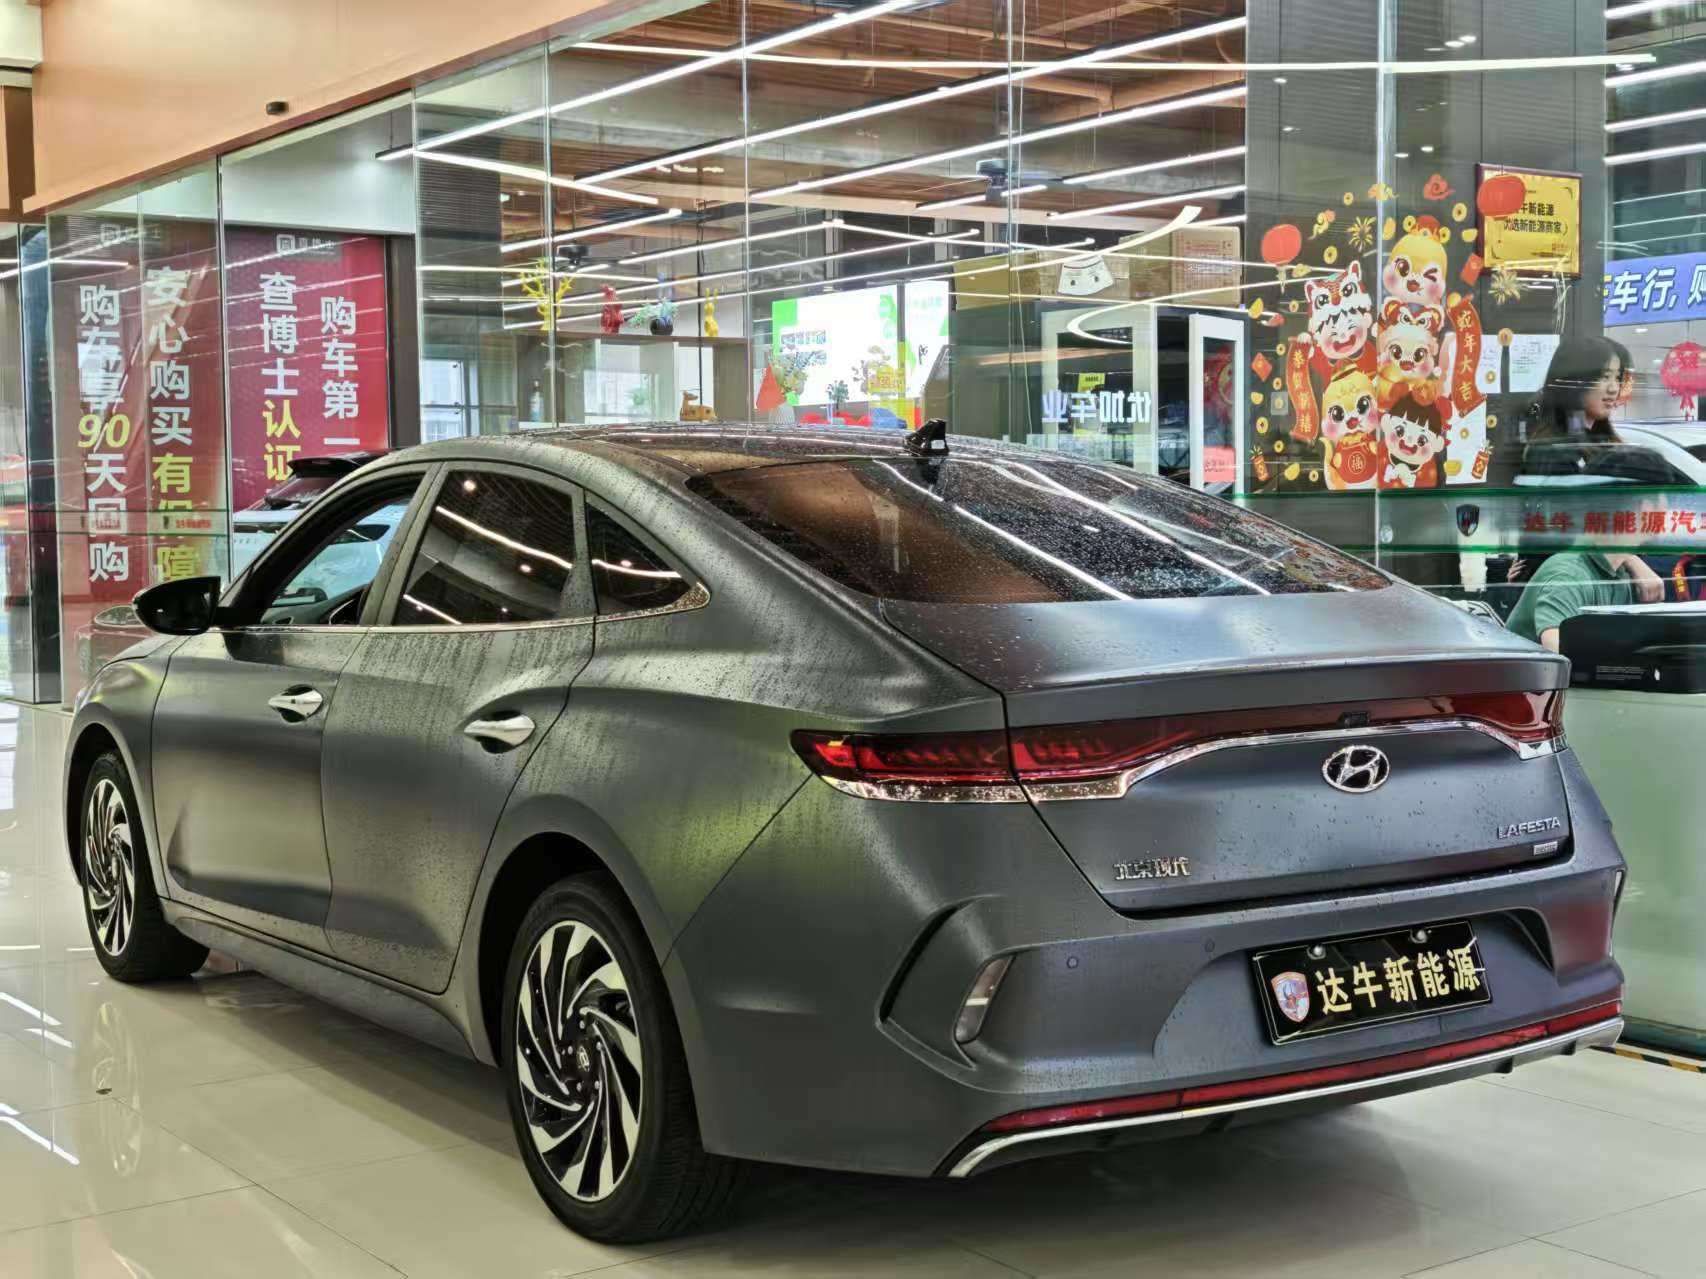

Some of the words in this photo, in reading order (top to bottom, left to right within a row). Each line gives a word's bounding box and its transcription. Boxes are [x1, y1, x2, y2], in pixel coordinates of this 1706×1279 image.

[320, 296, 361, 446] 购车第一
[1498, 816, 1561, 839] LAFESTA
[1113, 857, 1192, 880] 北京现代
[1315, 945, 1481, 1015] 达牛新能源
